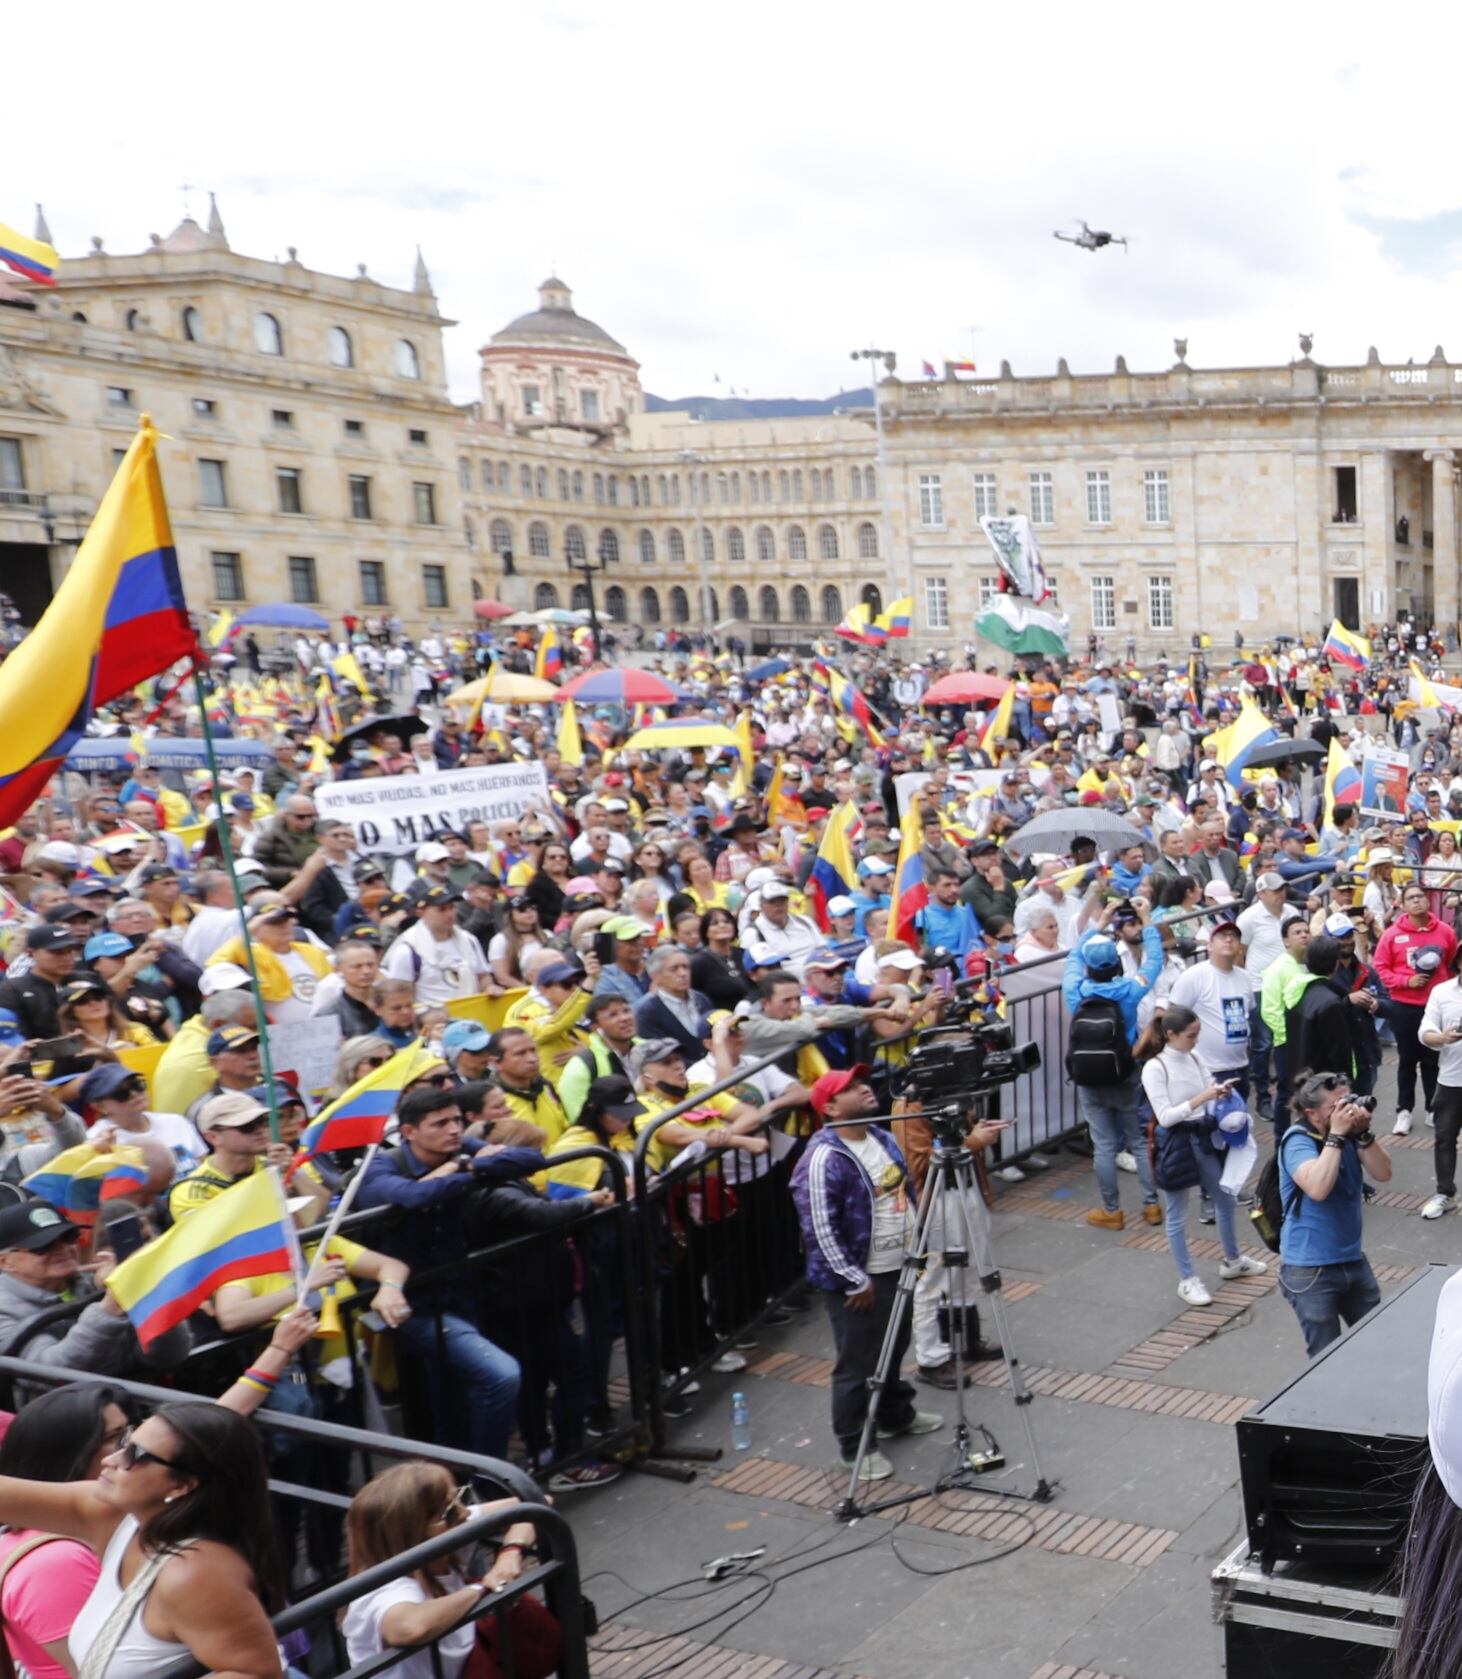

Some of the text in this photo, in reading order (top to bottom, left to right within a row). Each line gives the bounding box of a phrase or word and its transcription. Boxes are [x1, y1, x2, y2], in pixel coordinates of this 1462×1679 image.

[76, 756, 118, 770] TINTO
[324, 795, 344, 808] NO
[347, 791, 375, 805] MAS
[430, 783, 447, 796] NO
[450, 780, 476, 793] MAS
